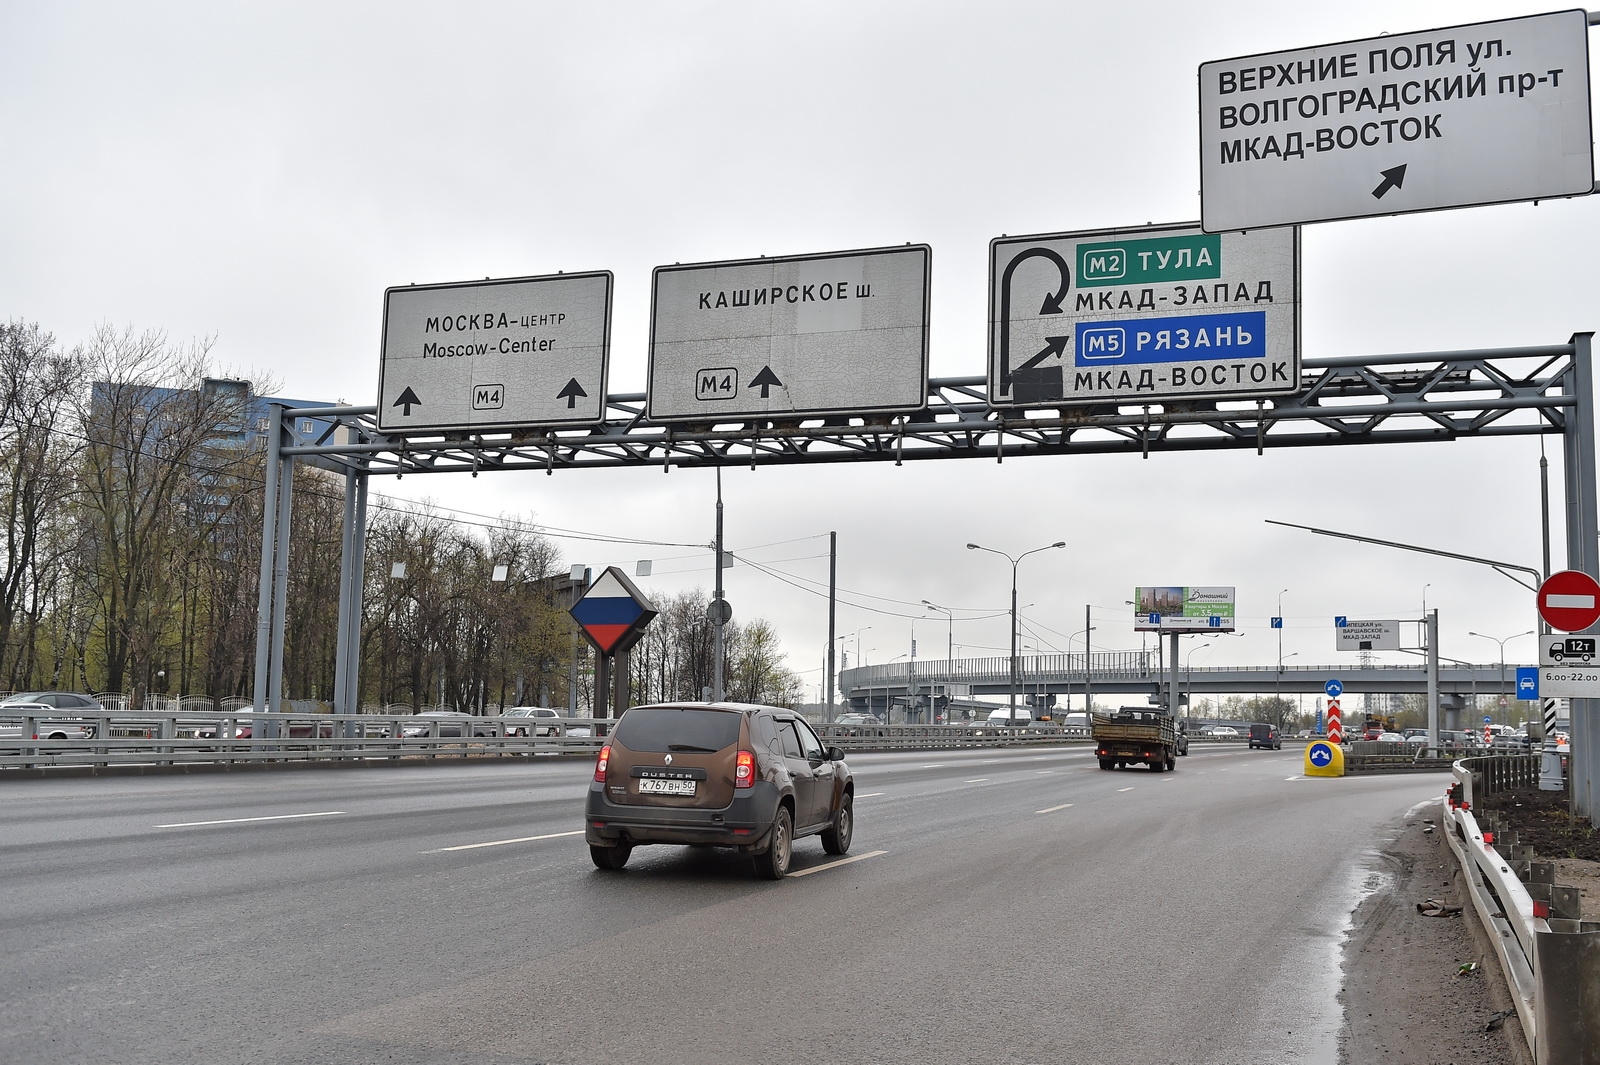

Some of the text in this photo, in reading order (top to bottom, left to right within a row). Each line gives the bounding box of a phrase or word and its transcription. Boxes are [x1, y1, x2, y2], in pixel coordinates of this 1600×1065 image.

[1218, 39, 1512, 96] ВЕРХНИЕ ПОЛЯ ул.
[1218, 67, 1564, 129] ВОЛГОГРАДСКИЙ пр-т
[1219, 113, 1442, 164] МКАД-ВОСТОК
[1089, 247, 1213, 273] М2 ТУЛА
[699, 281, 875, 310] КАШИРСКОЕ ш.
[1075, 280, 1274, 312] МКАД-ЗАПАД
[425, 312, 566, 333] МОСКВА-ЦЕНТР
[423, 337, 557, 359] Moscow-Center
[1088, 325, 1253, 353] М5 РЯЗАНЬ
[700, 375, 732, 393] М4
[1074, 361, 1289, 392] МКАД-ВОСТОК
[476, 390, 500, 404] М4
[1545, 672, 1598, 682] 6.00-22.00
